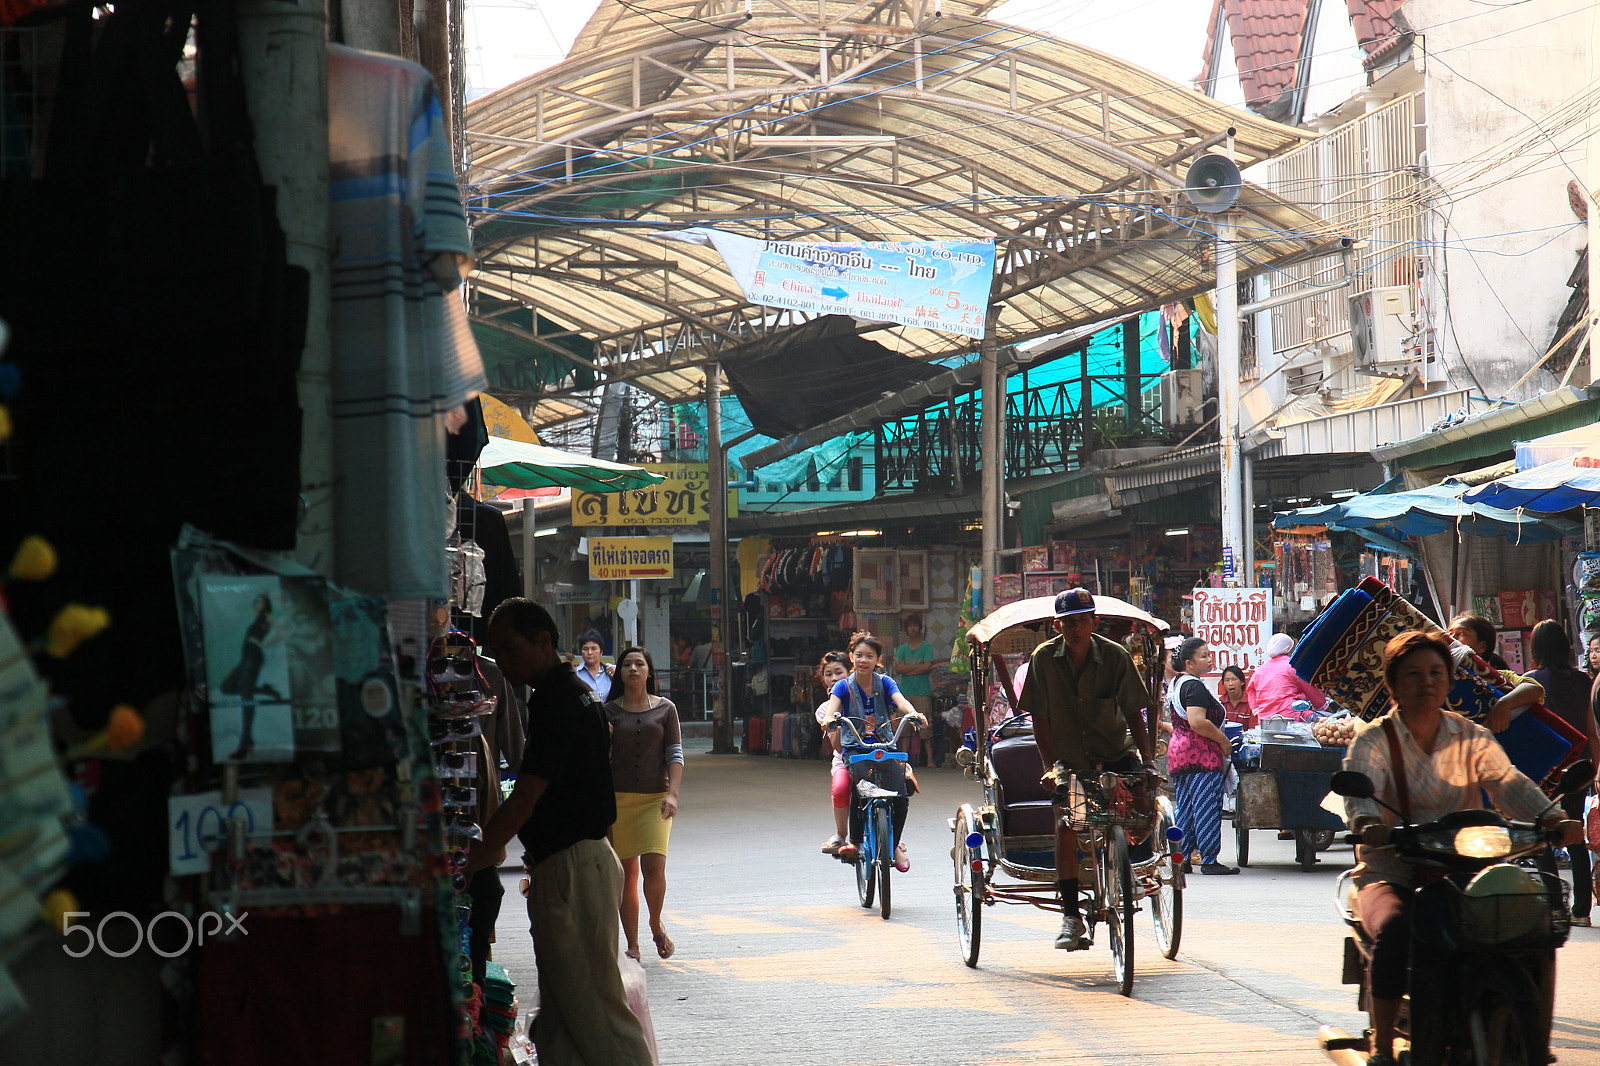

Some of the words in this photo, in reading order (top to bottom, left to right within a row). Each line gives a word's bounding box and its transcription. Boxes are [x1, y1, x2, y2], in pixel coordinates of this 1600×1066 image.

[907, 257, 936, 279] ไทย
[782, 279, 813, 294] China
[857, 290, 902, 308] Thailand
[946, 290, 961, 309] 5
[597, 568, 609, 578] 40
[611, 568, 627, 578] บาท
[1196, 624, 1260, 647] จอดรถ
